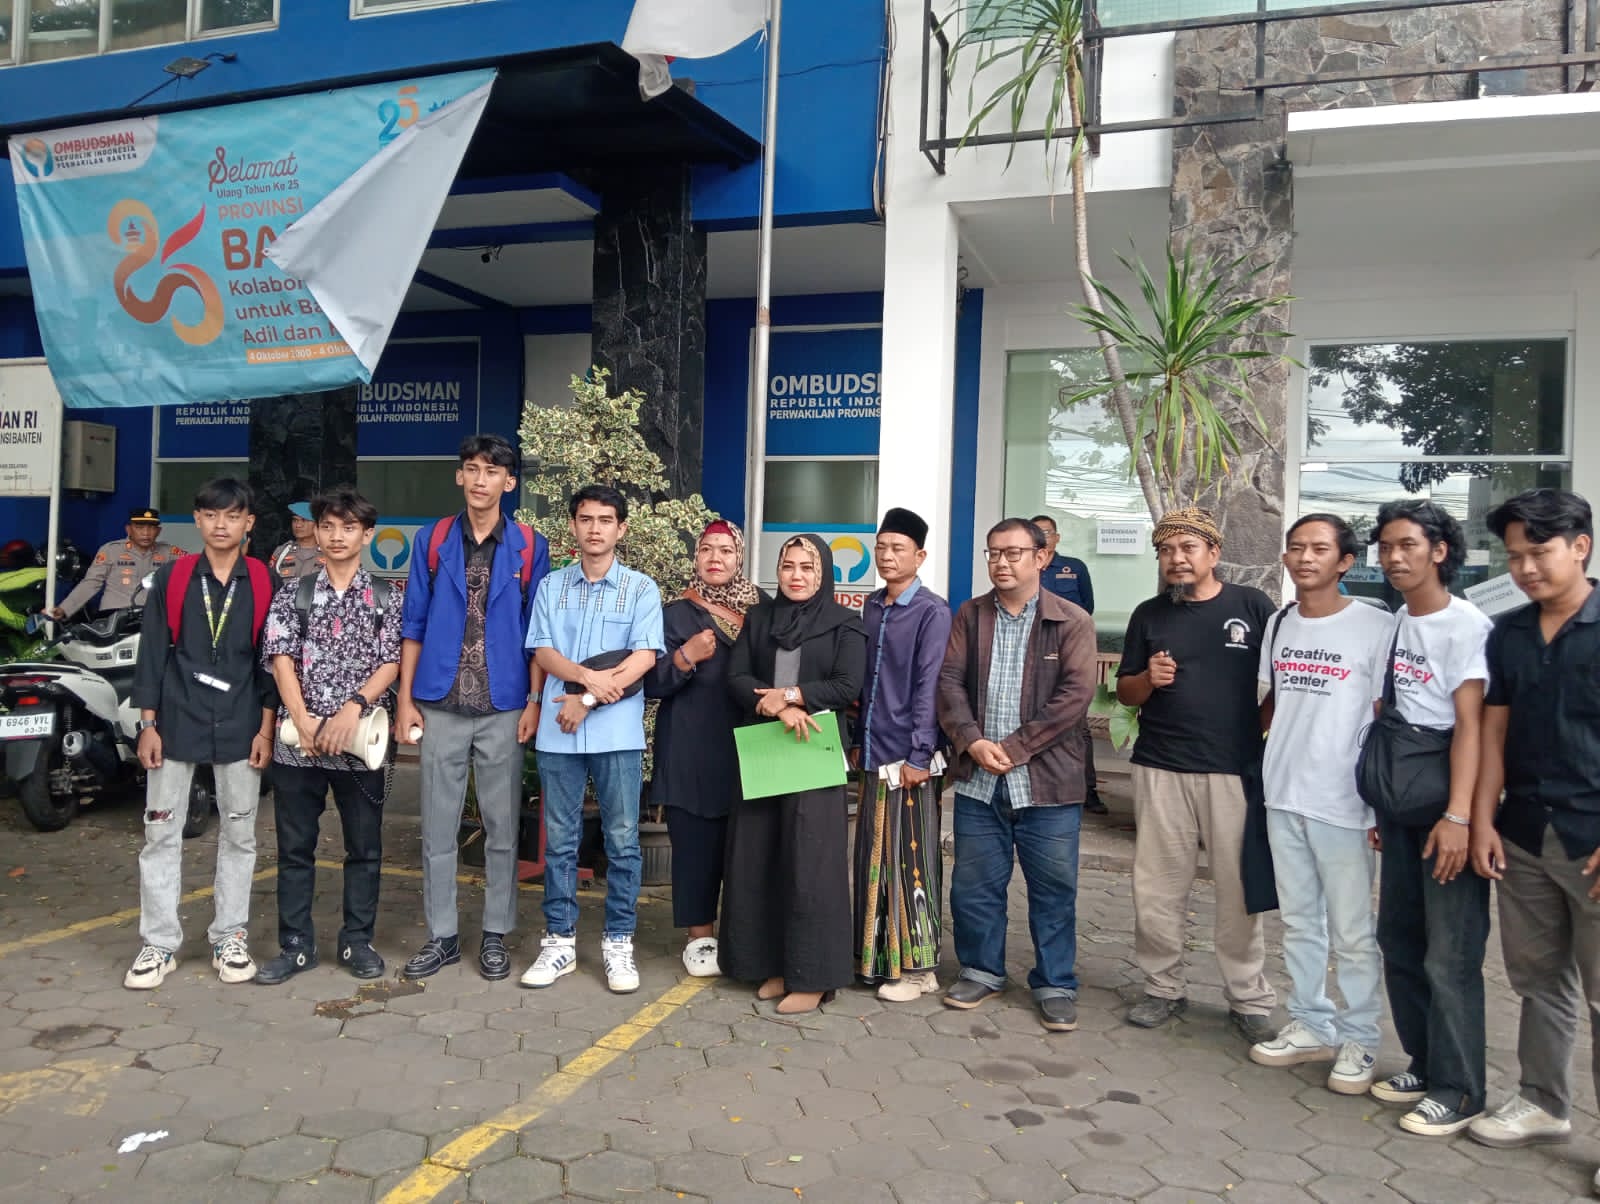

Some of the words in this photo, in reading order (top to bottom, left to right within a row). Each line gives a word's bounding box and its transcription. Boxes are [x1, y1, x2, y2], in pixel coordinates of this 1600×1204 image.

[54, 131, 135, 154] OMBUDSMAN
[55, 151, 91, 162] REPUBLIK
[94, 145, 136, 157] INDONESIA
[107, 152, 137, 162] BANTEN
[208, 146, 298, 192] Selamat
[216, 189, 242, 199] Ulang
[245, 184, 271, 195] Tahun
[273, 181, 286, 191] Ke
[288, 179, 300, 190] 25
[217, 196, 304, 222] PROVINSI
[222, 223, 293, 271] BA
[235, 300, 295, 320] untuk
[243, 326, 280, 344] Adil
[283, 324, 322, 341] dan
[256, 350, 289, 361] Oktober
[357, 381, 460, 401] BUDSMAN
[770, 372, 882, 396] OMBUDS
[392, 402, 459, 413] INDONESIA
[770, 397, 842, 408] REPUBLIK
[0, 410, 20, 429] AN
[24, 410, 37, 429] RI
[176, 407, 228, 416] REPUBLIK
[384, 413, 422, 422] PROVINSI
[424, 412, 459, 422] BANTEN
[770, 408, 835, 419] PERWAKILAN
[838, 407, 881, 418] PROVINS
[176, 416, 223, 425] PERWAKILAN
[12, 432, 42, 444] BANTEN
[1281, 646, 1342, 663] Creative
[1274, 660, 1351, 681] Democracy
[6, 716, 30, 727] 6946
